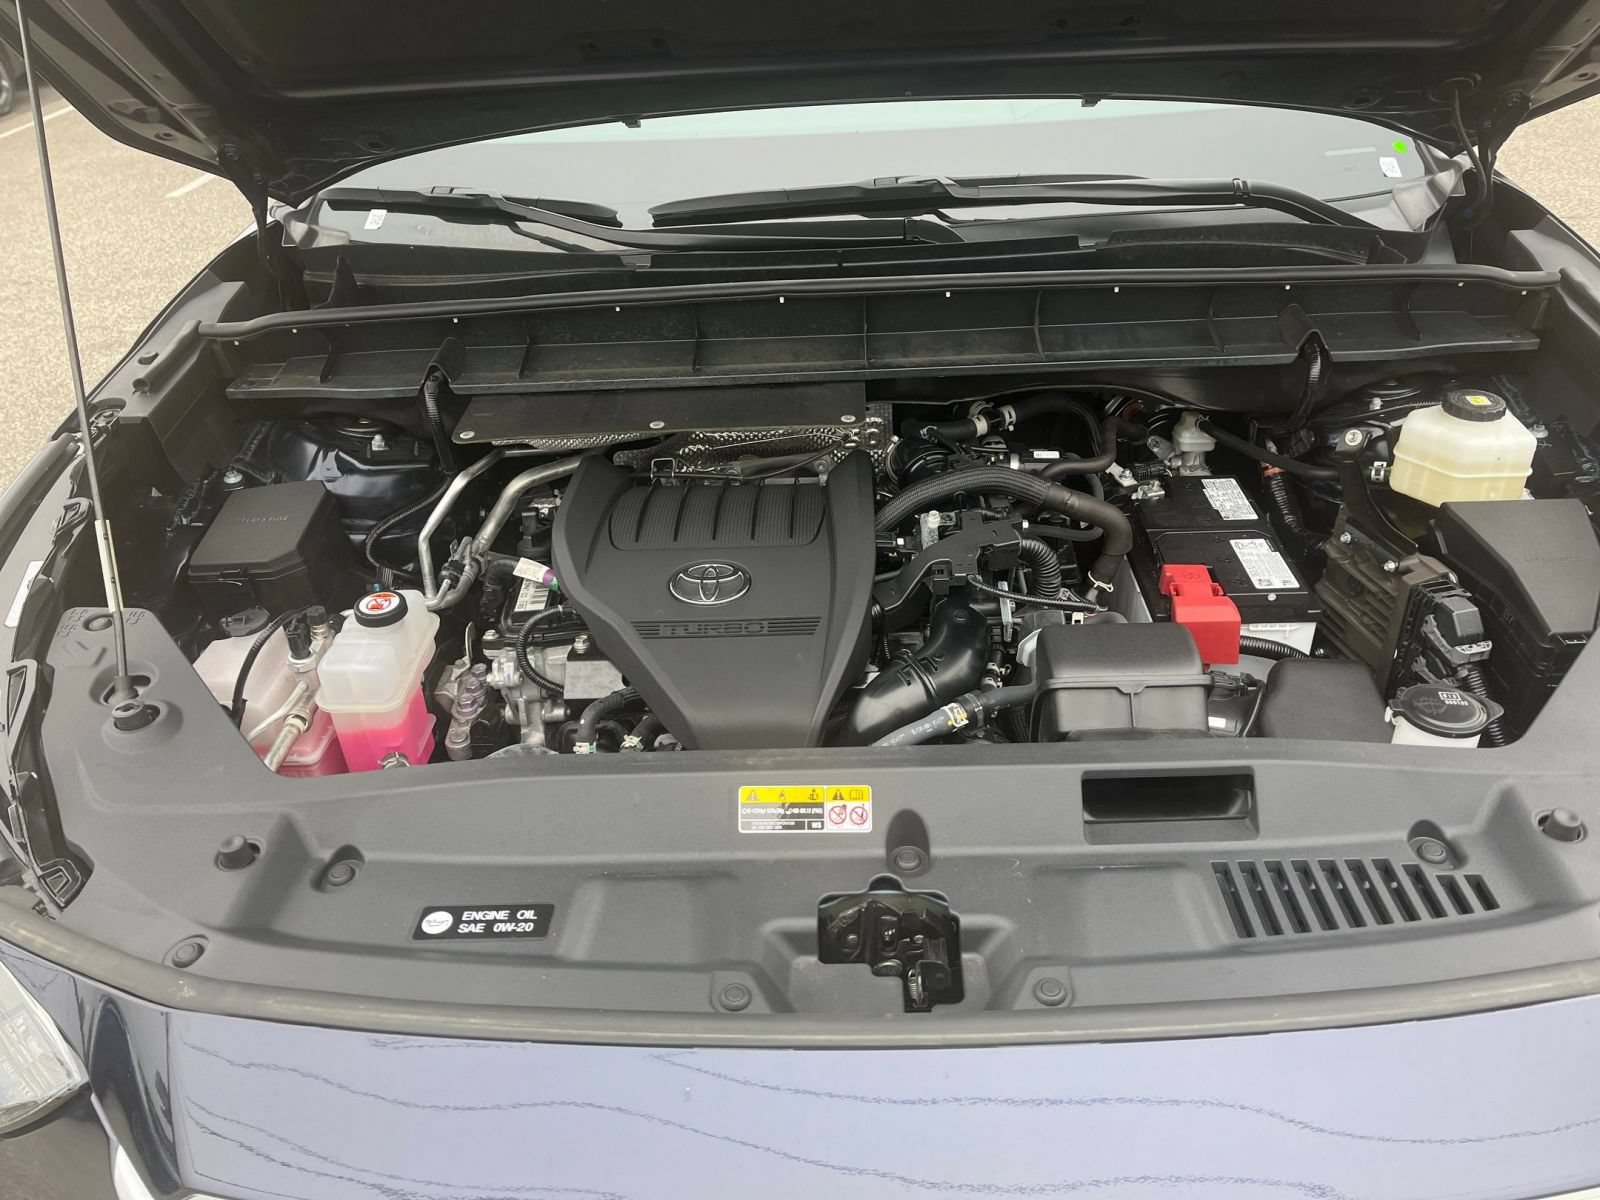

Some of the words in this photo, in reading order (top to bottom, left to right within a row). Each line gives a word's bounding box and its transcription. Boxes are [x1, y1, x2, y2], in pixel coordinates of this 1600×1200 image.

[662, 622, 765, 635] TURBO
[461, 910, 511, 921] ENGINE
[516, 909, 538, 920] OIL
[457, 923, 487, 933] SAE
[493, 922, 534, 933] 0W-20
